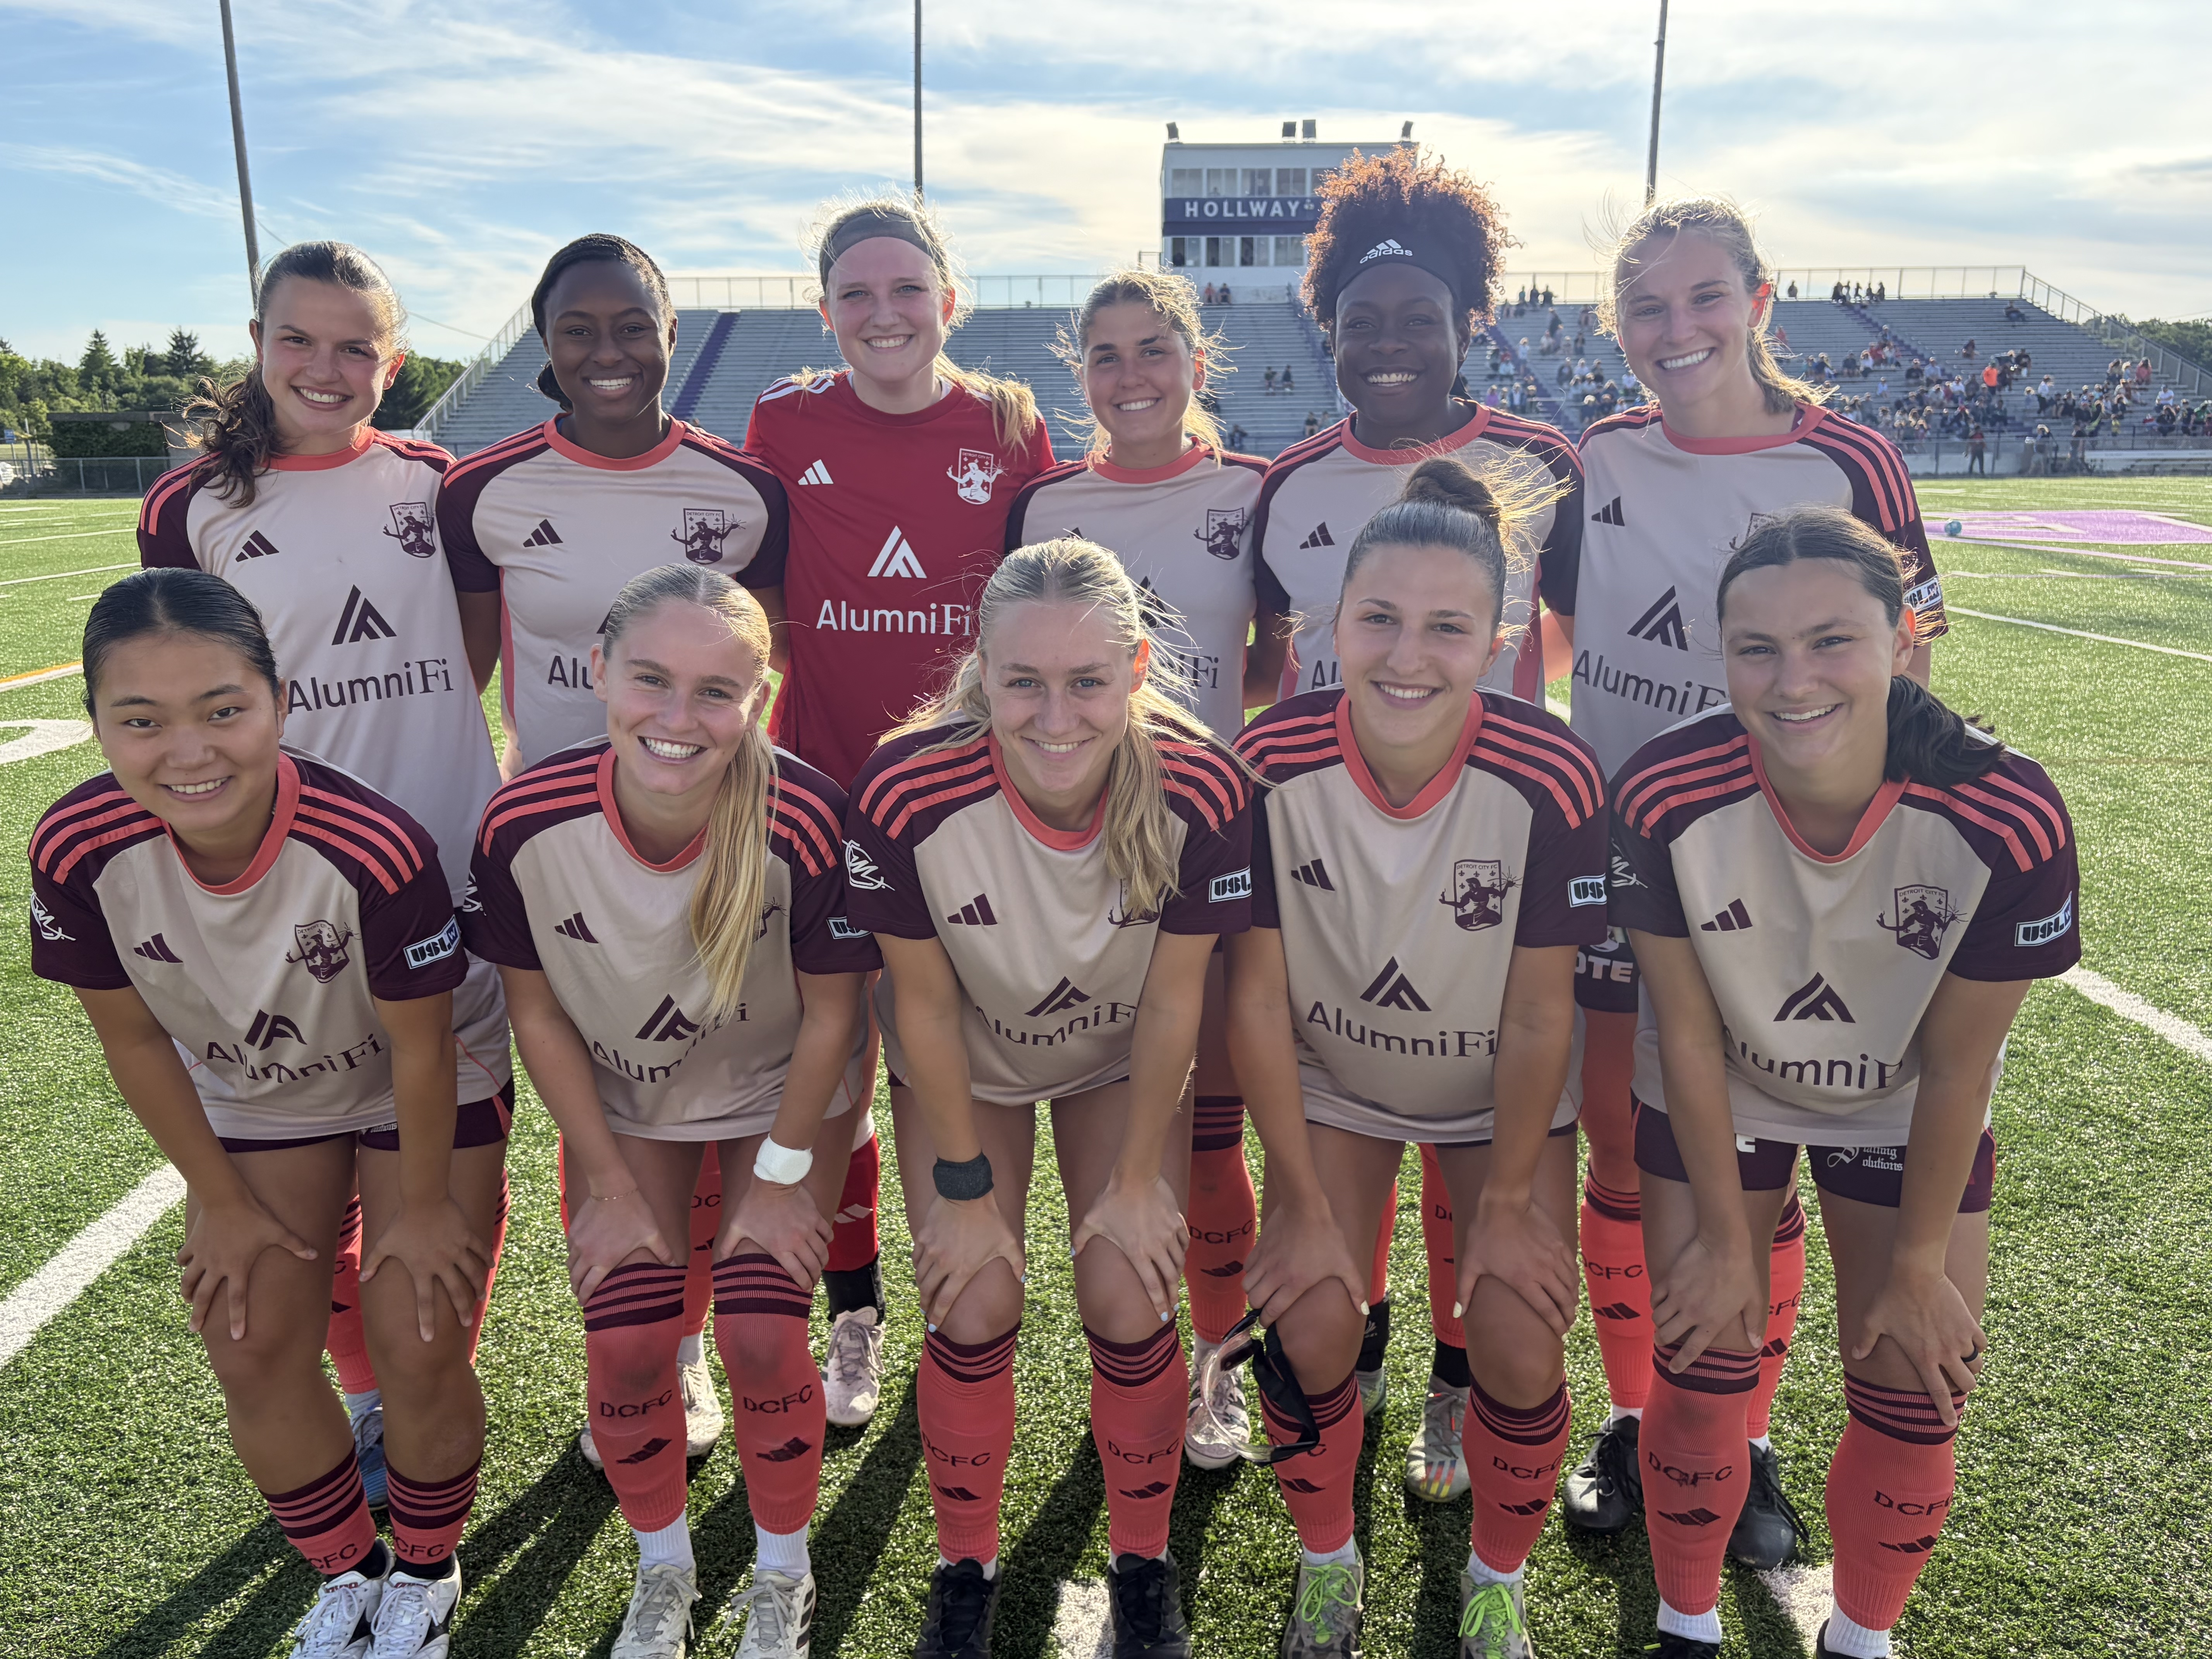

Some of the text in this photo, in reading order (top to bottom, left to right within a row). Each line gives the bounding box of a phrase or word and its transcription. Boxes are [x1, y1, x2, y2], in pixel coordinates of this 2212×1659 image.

[1185, 200, 1300, 218] HOLLWAY
[1359, 247, 1413, 264] adidas
[816, 599, 970, 636] AlumniFi
[288, 659, 454, 714] AlumniFi
[1214, 874, 1251, 896] USL
[1573, 881, 1604, 900] US
[1899, 889, 1923, 897] DETROIT
[2022, 916, 2064, 941] USL
[410, 936, 452, 962] USL
[1307, 1000, 1498, 1058] AlumniFi
[206, 1034, 384, 1084] AlumniFi
[1190, 1219, 1253, 1244] DCFC
[600, 1389, 673, 1418] DCFC
[743, 1384, 812, 1414] DCFC
[922, 1430, 990, 1467] DCFC
[1108, 1437, 1180, 1464] DCFC
[1493, 1453, 1563, 1479] DCFC
[1648, 1451, 1732, 1487] DCFC
[394, 1537, 444, 1557] CFC
